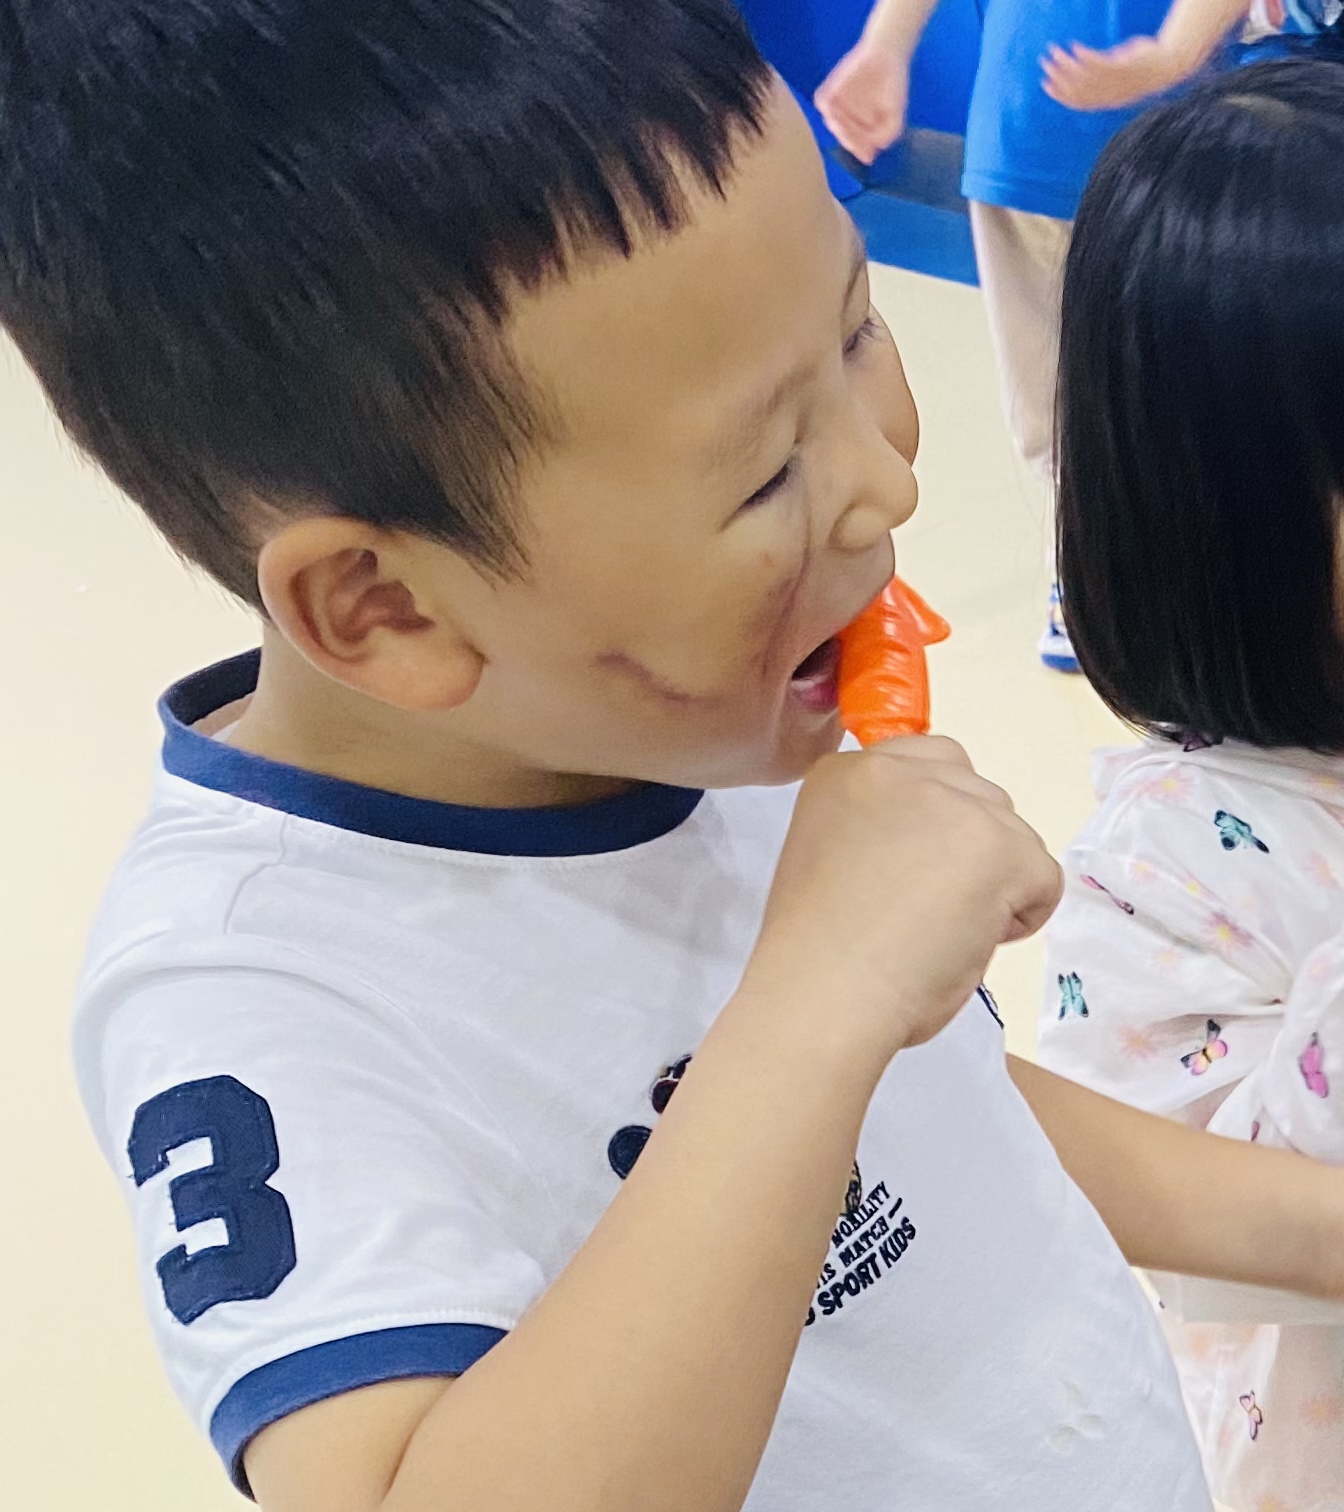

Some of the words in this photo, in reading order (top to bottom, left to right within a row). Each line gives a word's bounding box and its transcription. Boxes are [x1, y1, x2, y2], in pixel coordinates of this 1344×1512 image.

[127, 1074, 297, 1326] 3
[817, 1252, 882, 1316] SPORT
[879, 1216, 916, 1269] KIDS
